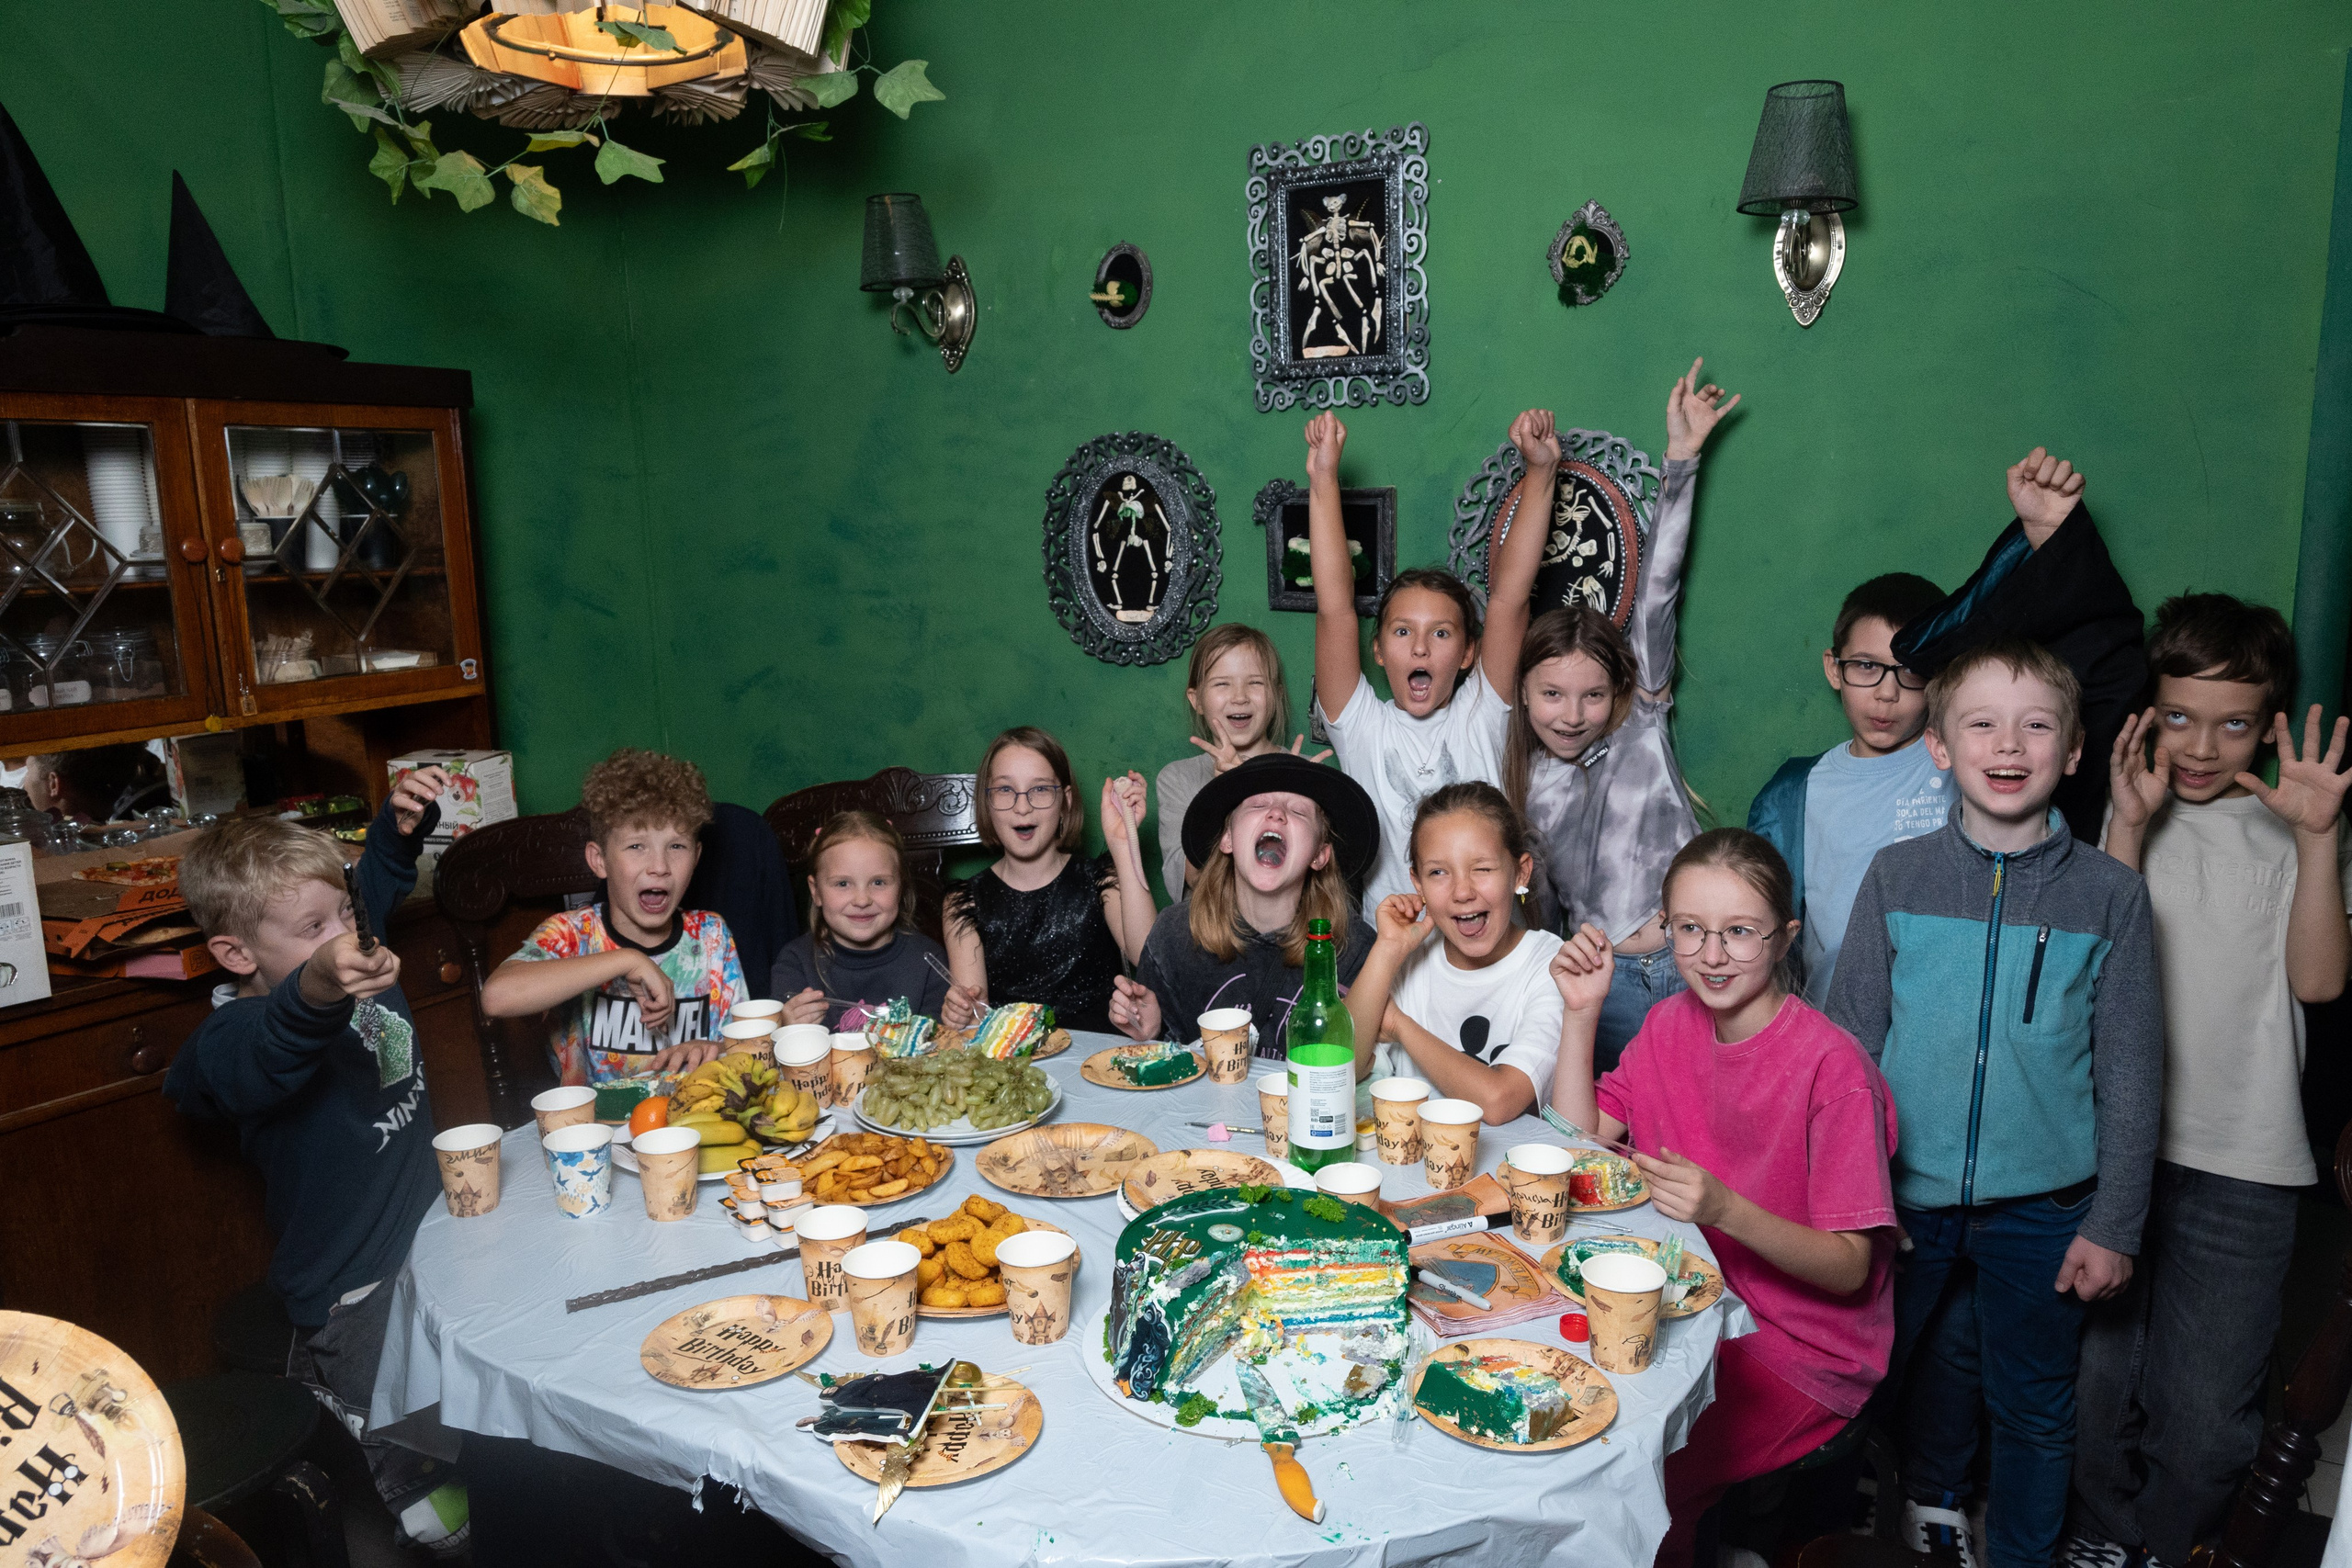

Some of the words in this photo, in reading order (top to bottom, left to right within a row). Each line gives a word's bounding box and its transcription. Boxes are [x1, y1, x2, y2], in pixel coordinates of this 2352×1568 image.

[1585, 755, 1598, 767] ONLY
[1597, 747, 1609, 757] YOU
[1920, 807, 1933, 817] DEL
[1905, 818, 1930, 829] TENGO
[716, 1324, 787, 1353] Happy
[676, 1337, 766, 1375] Birthday
